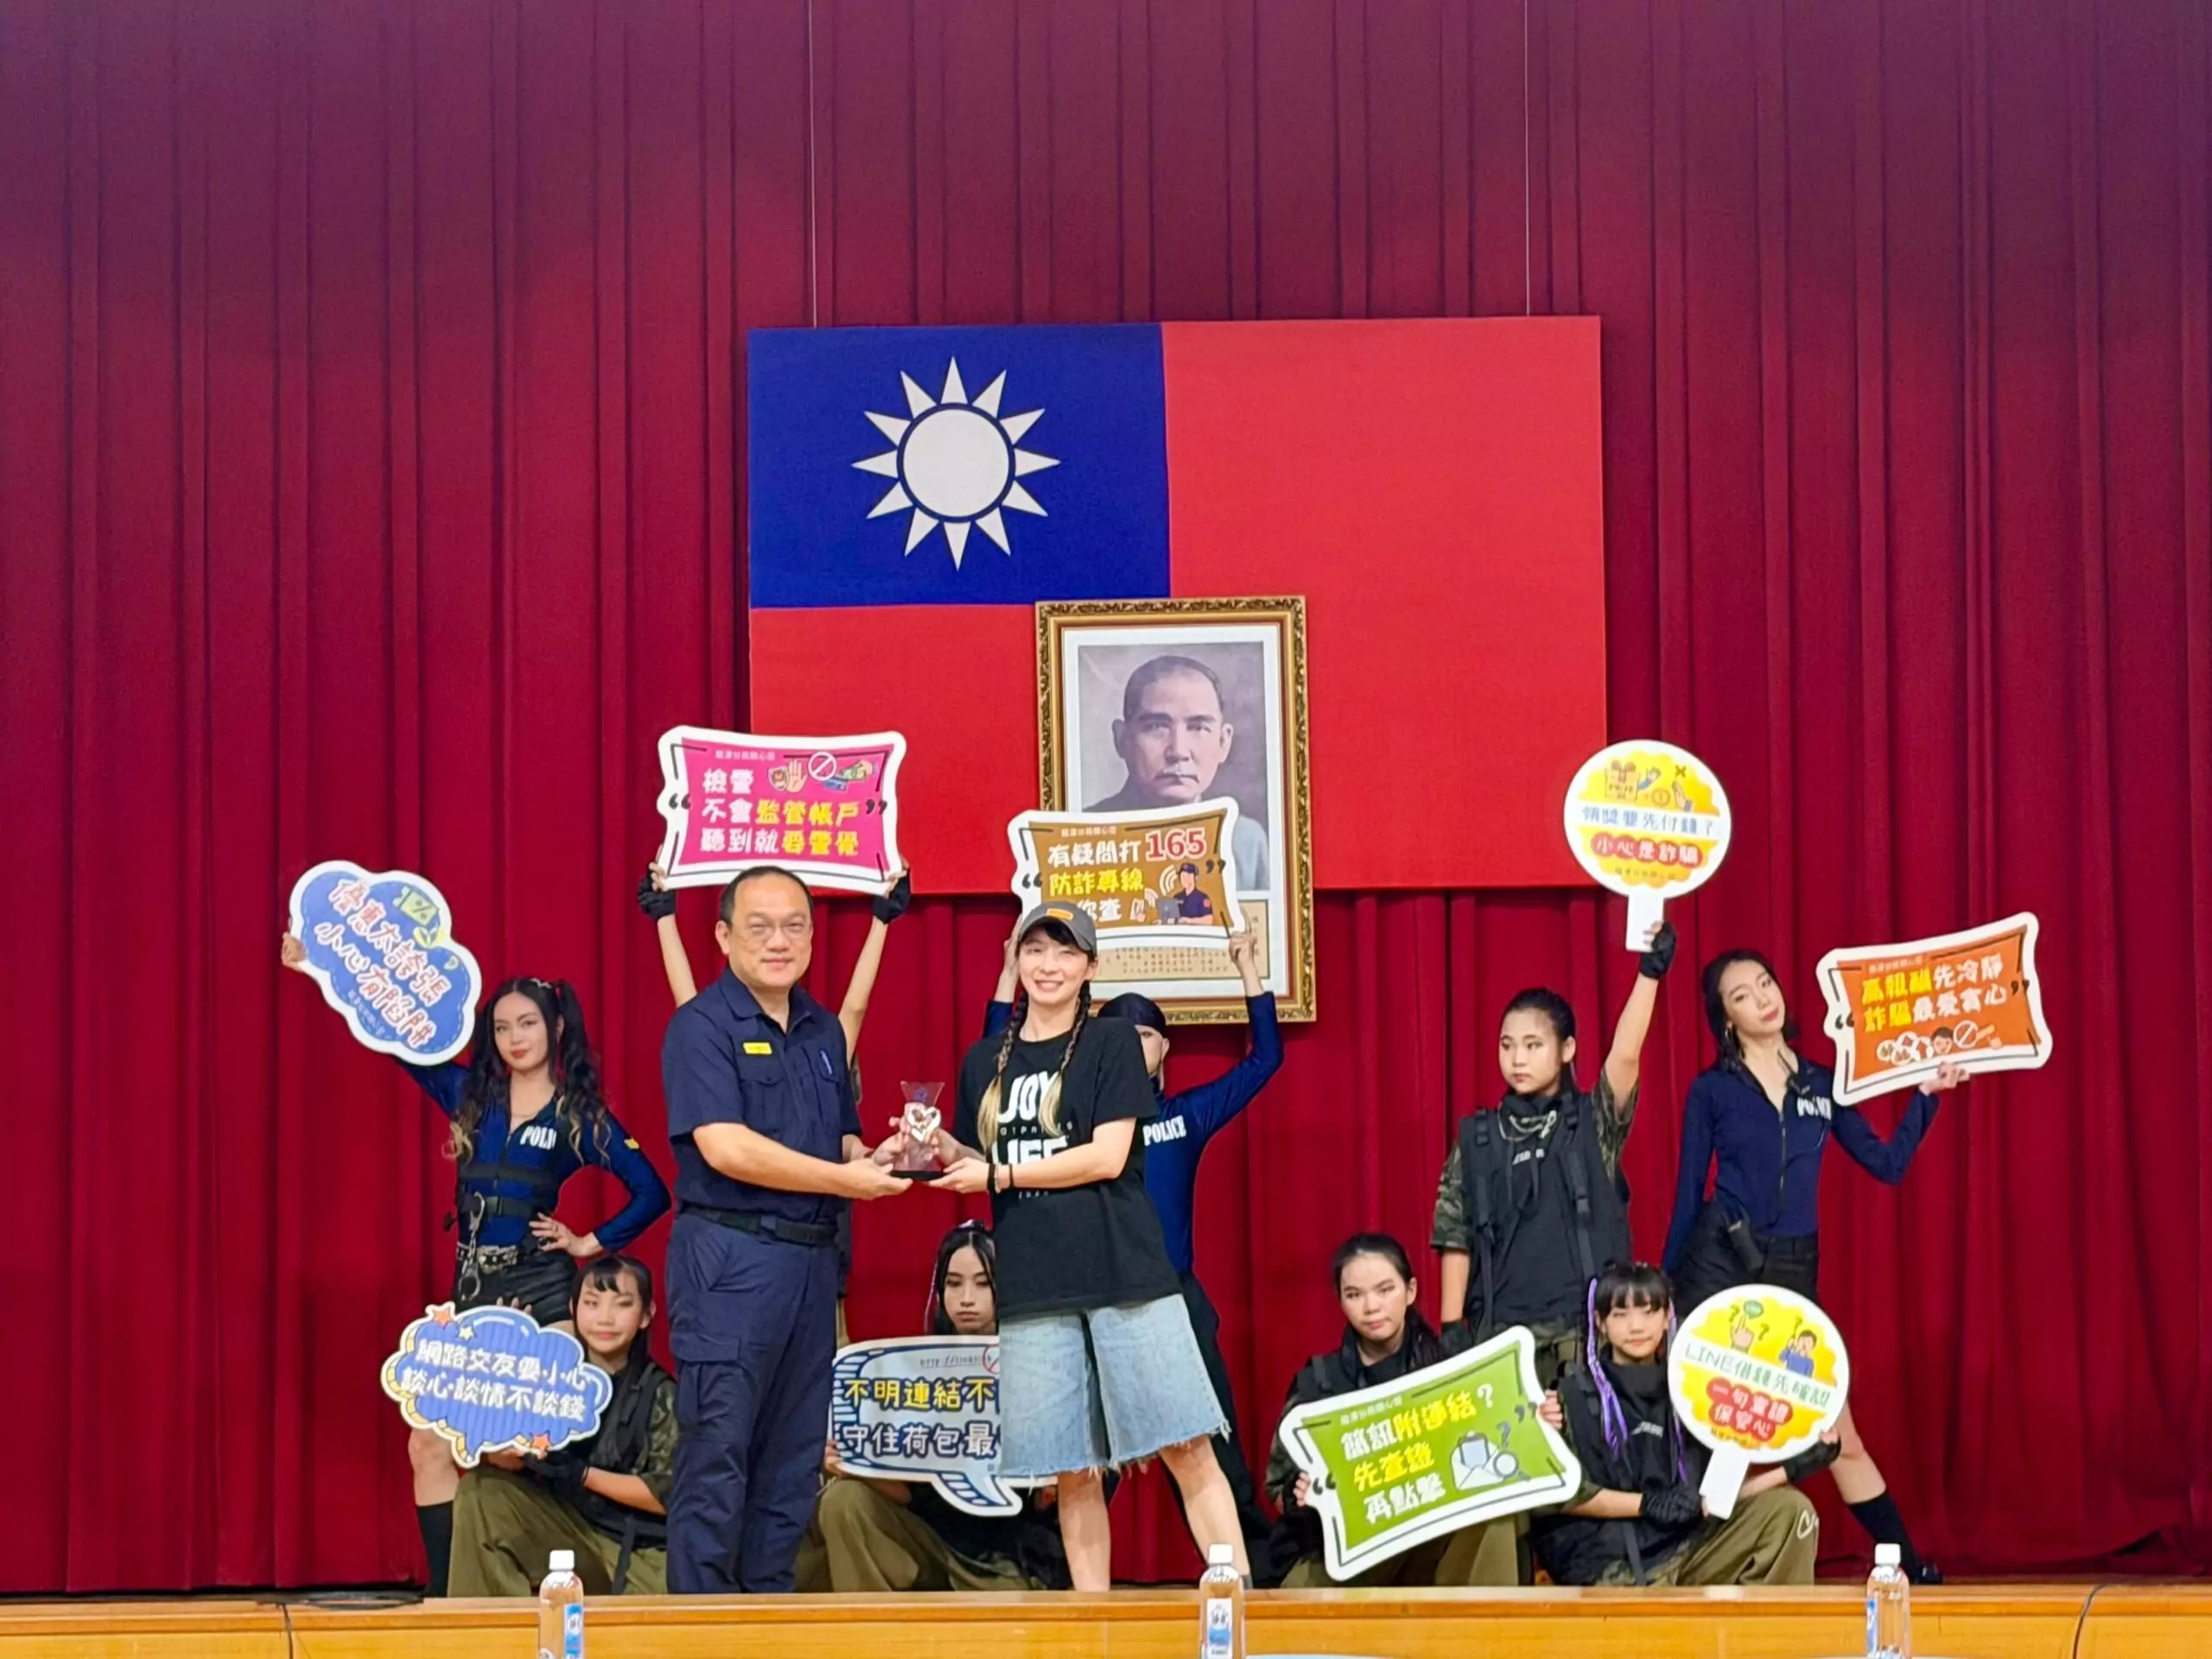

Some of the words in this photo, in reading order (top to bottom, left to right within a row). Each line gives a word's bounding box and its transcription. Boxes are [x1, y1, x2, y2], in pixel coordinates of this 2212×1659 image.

[702, 768, 754, 794] 檢警
[701, 798, 861, 827] 不會監管帳戶
[700, 828, 860, 856] 聽到就要警覺
[1049, 868, 1144, 897] 防詐專線
[315, 922, 437, 1048] 小心有陷阱
[1142, 1115, 1187, 1147] POLICE
[416, 1338, 586, 1391] 網路交友要小心
[400, 1366, 587, 1423] 談心談情不談錢
[842, 1376, 996, 1411] 不明連結不
[842, 1422, 996, 1458] 守住荷包最
[1363, 1471, 1447, 1525] 再點擊
